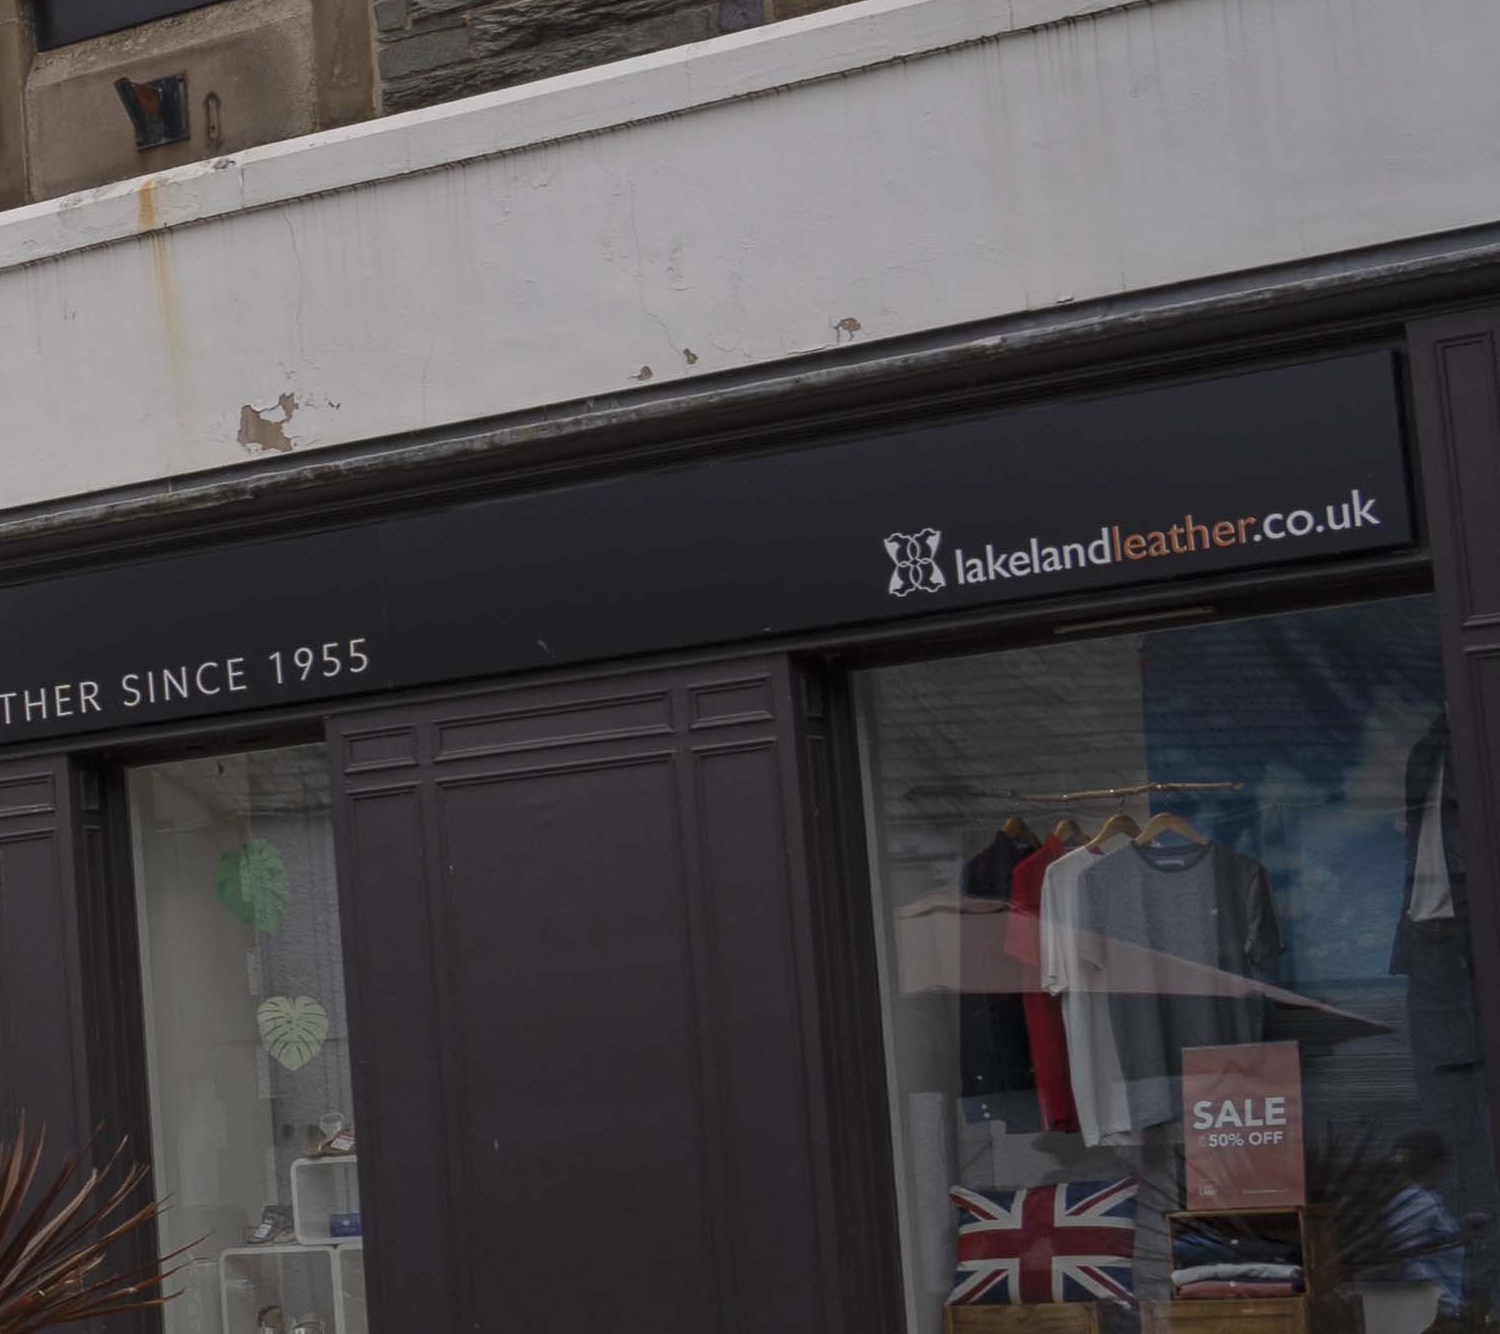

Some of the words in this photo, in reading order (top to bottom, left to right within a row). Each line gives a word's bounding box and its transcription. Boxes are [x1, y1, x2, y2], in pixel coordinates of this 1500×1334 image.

[955, 488, 1380, 587] lakelandleather.co.uk
[120, 656, 248, 708] SINCE
[266, 637, 372, 686] 1955
[1193, 1096, 1287, 1130] SALE
[1209, 1132, 1245, 1148] 50%
[1248, 1131, 1284, 1146] OFF
